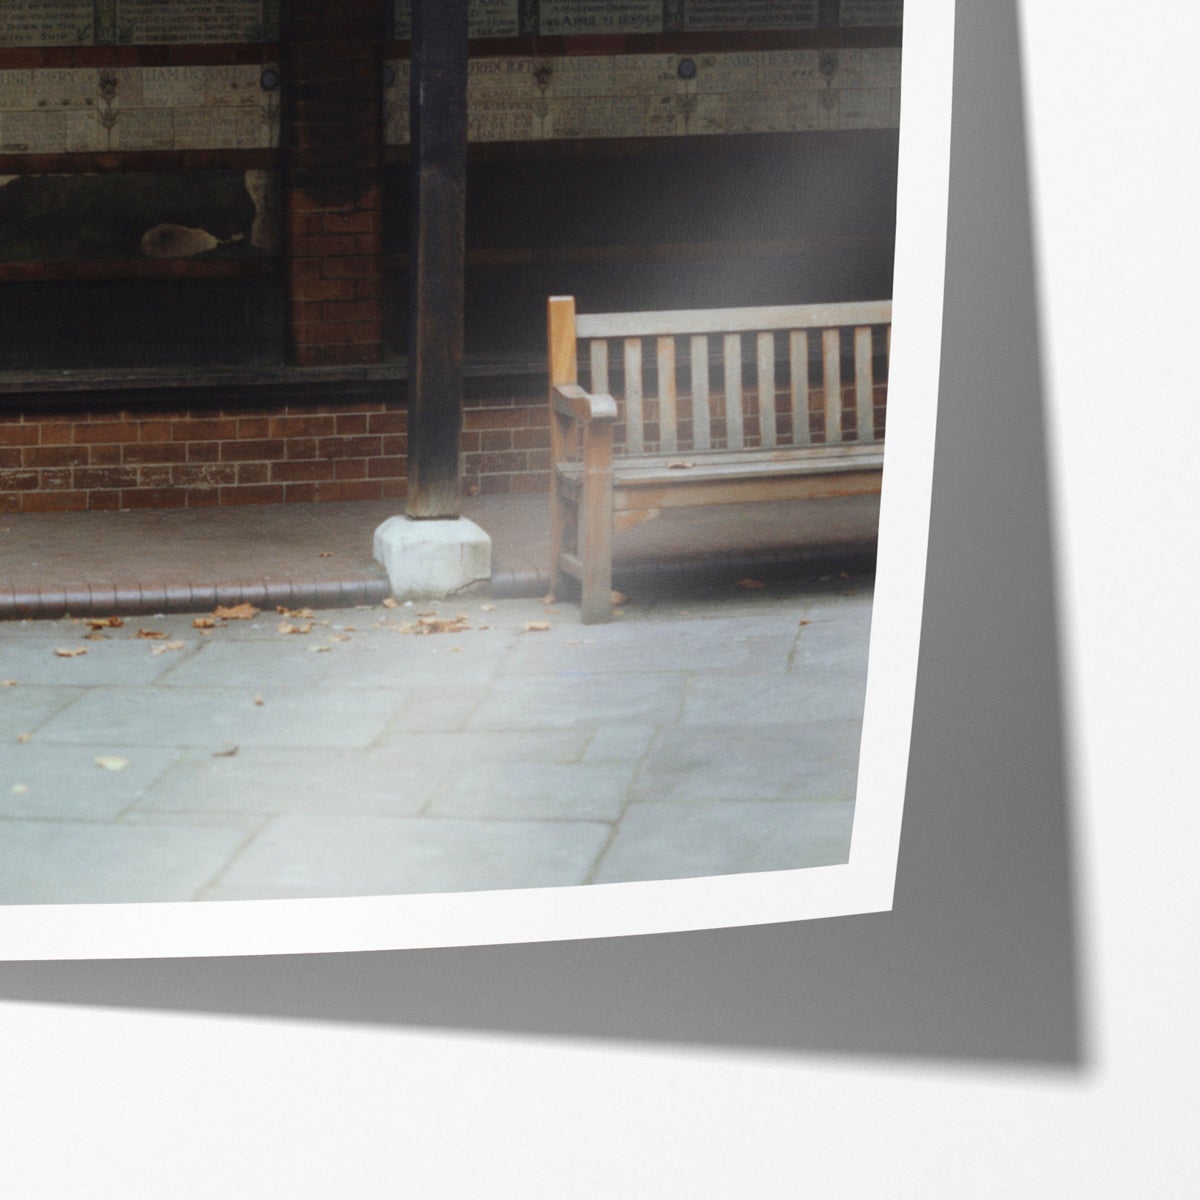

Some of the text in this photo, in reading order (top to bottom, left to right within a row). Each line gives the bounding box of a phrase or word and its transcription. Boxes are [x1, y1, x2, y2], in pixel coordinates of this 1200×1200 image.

[560, 15, 597, 27] APRIL
[7, 23, 38, 31] DOWN
[40, 32, 68, 40] SHIP
[121, 68, 178, 82] WILLIAM
